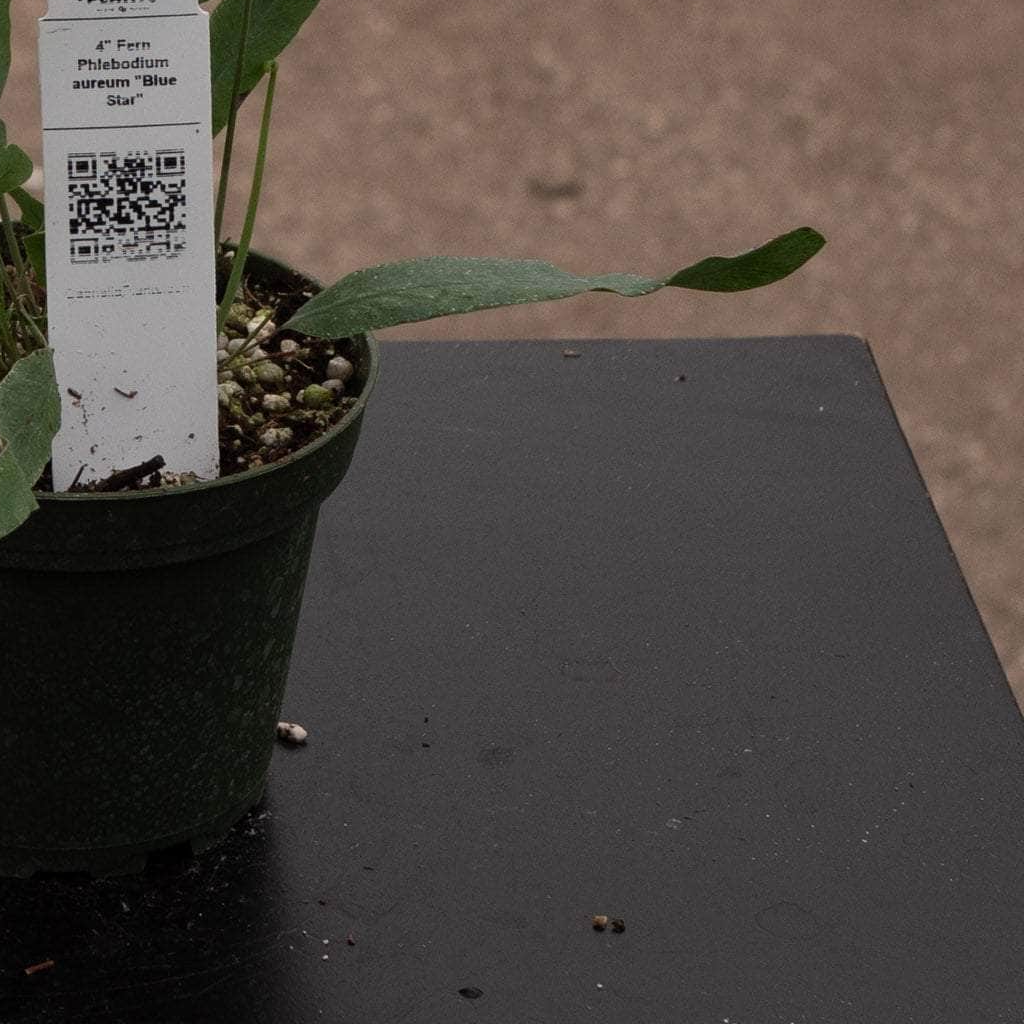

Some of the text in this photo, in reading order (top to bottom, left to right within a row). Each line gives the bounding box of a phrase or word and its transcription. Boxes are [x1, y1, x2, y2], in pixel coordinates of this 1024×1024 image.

[117, 39, 151, 51] Fern
[77, 57, 169, 70] Phlebodium
[72, 75, 177, 89] aureum "Blue
[107, 93, 143, 106] Star"
